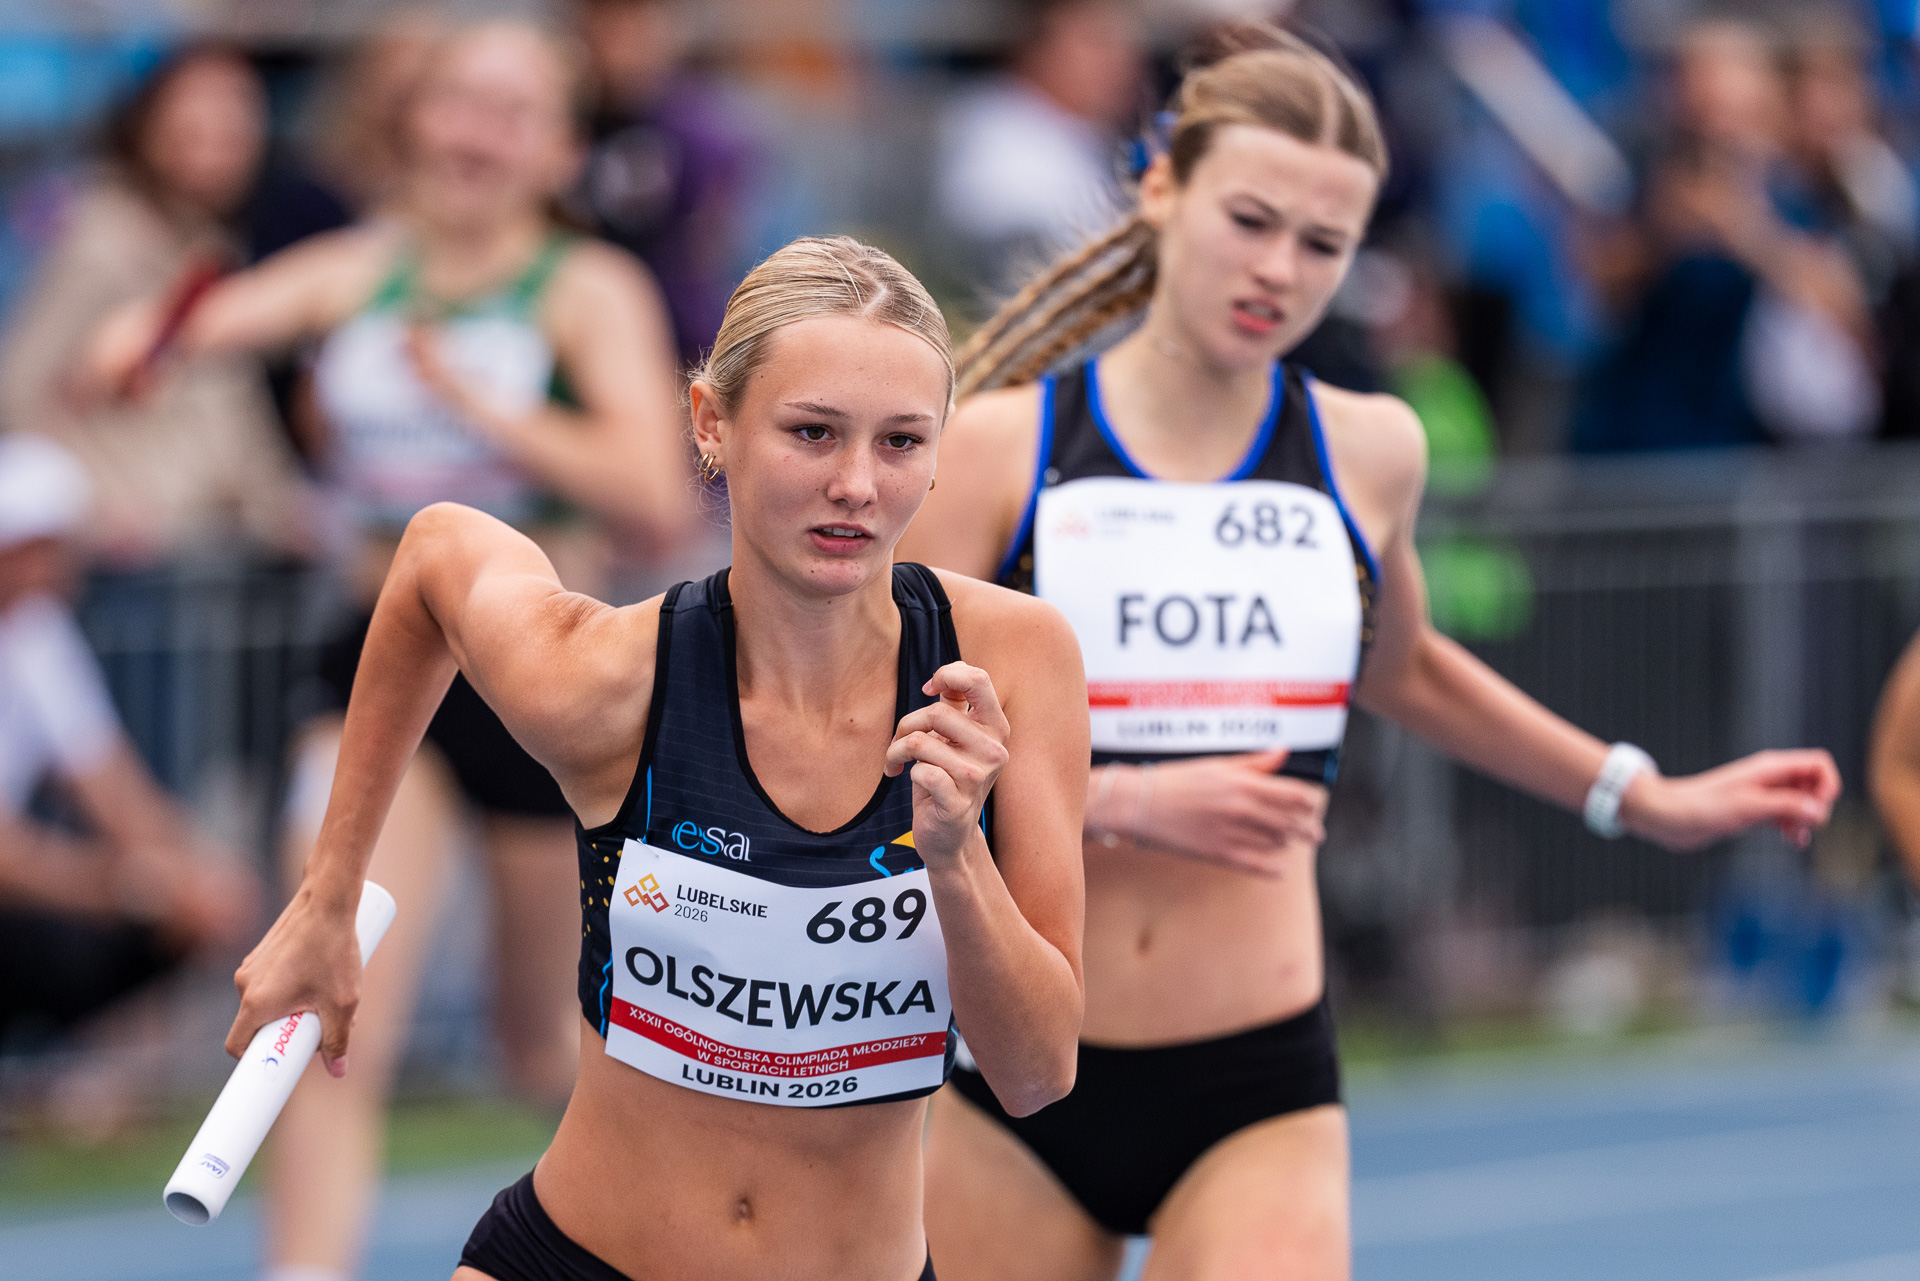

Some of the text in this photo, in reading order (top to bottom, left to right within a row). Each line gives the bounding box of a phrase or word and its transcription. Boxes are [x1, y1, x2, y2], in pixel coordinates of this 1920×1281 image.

[1215, 500, 1318, 548] 682
[1117, 594, 1282, 646] FOTA
[672, 820, 751, 862] esa
[674, 903, 709, 923] 2026
[676, 884, 768, 918] LUBELSKIE
[806, 888, 927, 944] 689
[625, 946, 936, 1029] OLSZEWSKA
[274, 1011, 305, 1057] polan
[629, 1006, 928, 1066] XXXII OGÓLNOPOLSKA OLIMPIADA MŁODZIEŻY
[682, 1063, 858, 1099] LUBLIN 2026
[696, 1049, 849, 1077] W SPORTACH LETNICH
